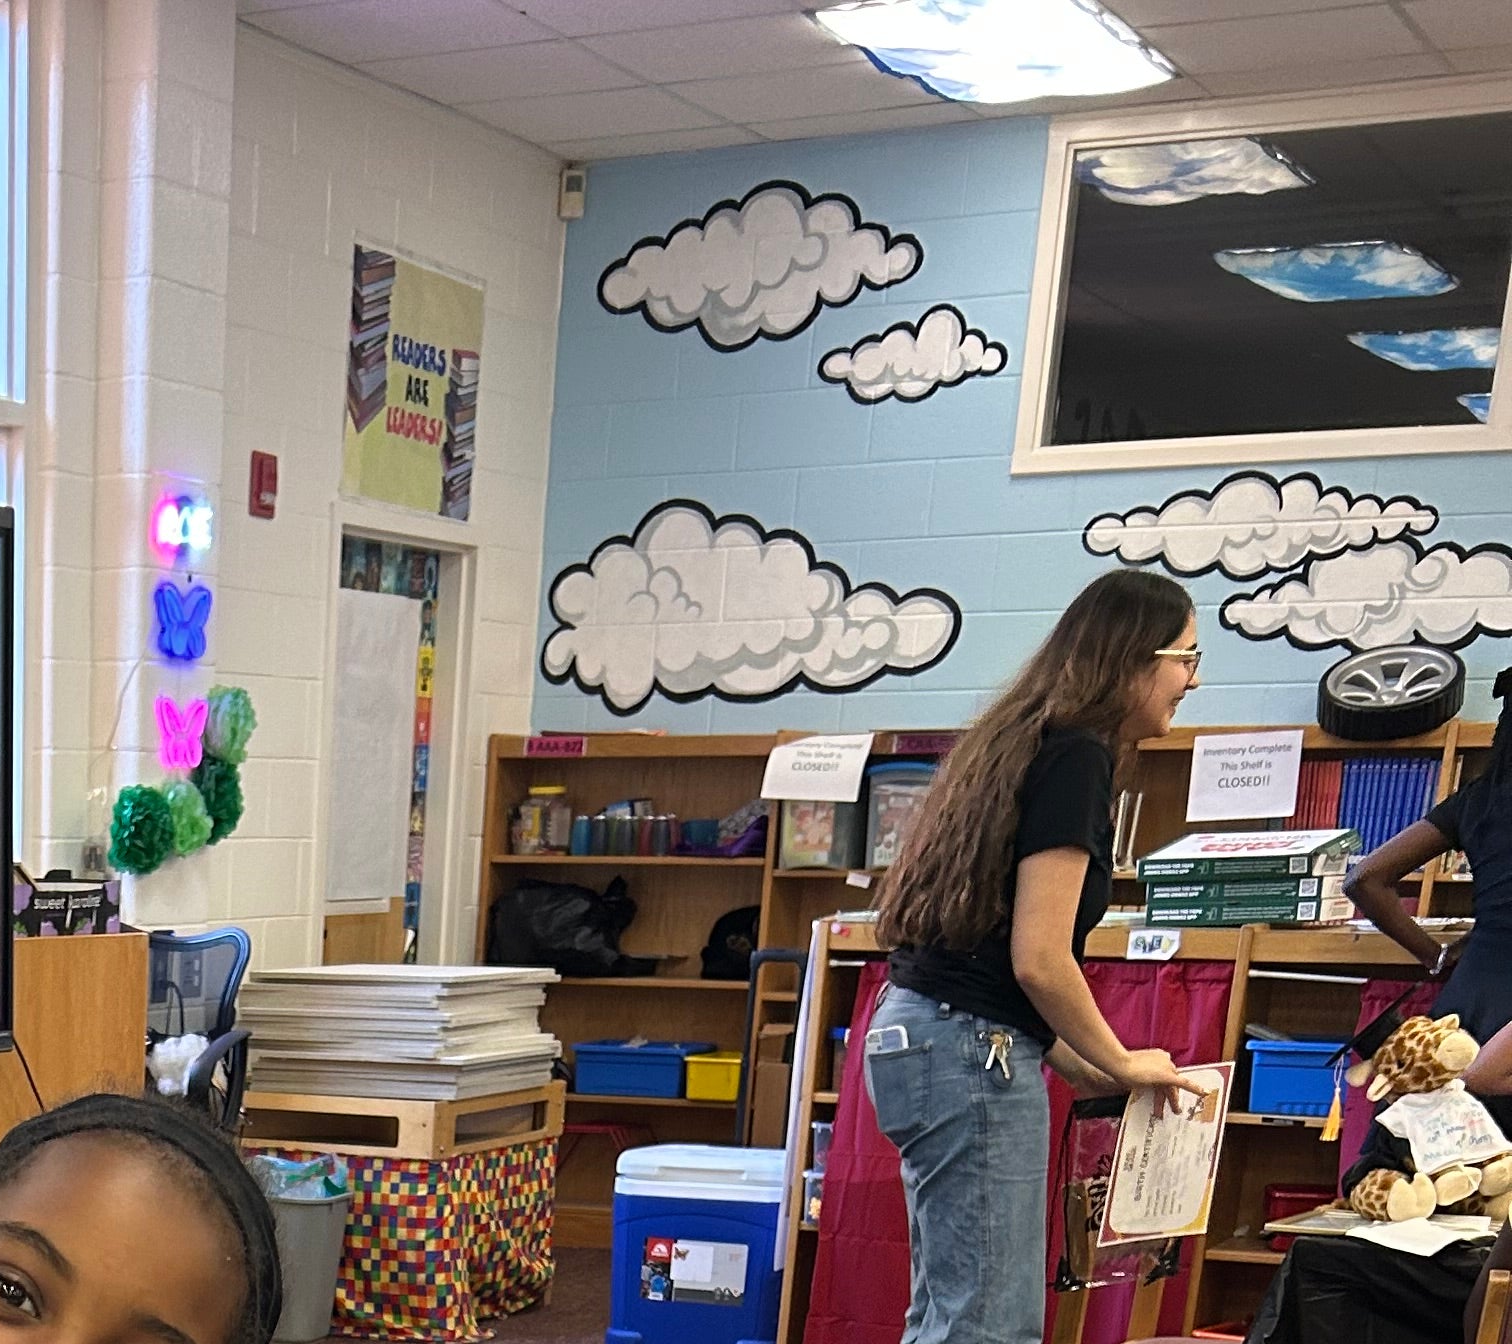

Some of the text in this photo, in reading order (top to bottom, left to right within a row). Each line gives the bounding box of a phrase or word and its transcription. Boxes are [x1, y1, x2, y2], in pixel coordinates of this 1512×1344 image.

[392, 334, 446, 376] READERS
[405, 373, 429, 407] ARE
[386, 406, 443, 446] LEADERS!
[1204, 743, 1292, 757] Inventory Complete
[1220, 760, 1272, 771] This Shelf is
[1217, 776, 1270, 789] CLOSED!!
